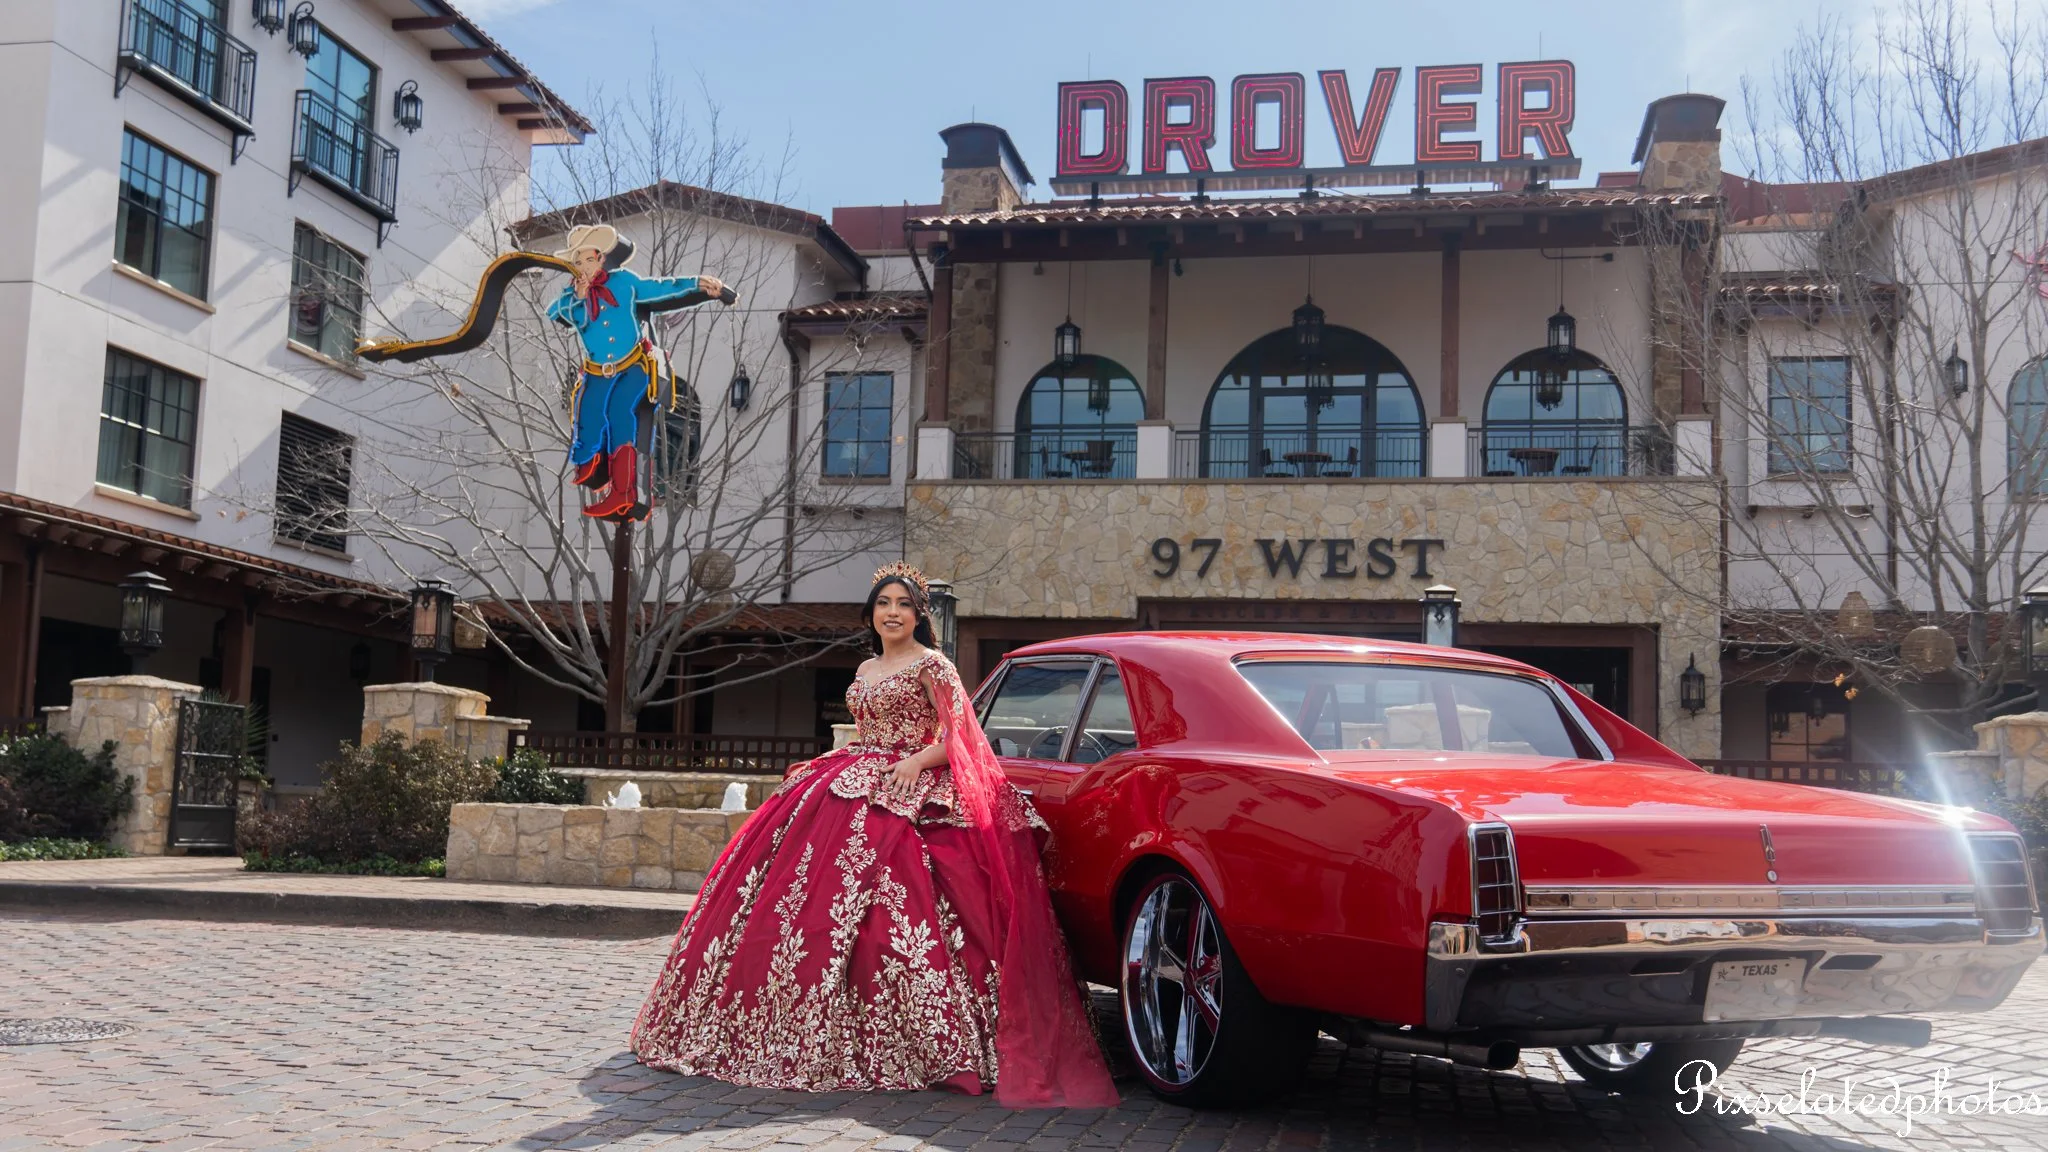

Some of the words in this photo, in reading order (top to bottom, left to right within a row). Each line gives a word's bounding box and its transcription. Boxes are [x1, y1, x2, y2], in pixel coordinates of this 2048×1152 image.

[1057, 59, 1577, 176] DROVER
[1151, 537, 1223, 580] 97
[1253, 537, 1445, 580] WEST
[1742, 964, 1779, 977] TEXAS
